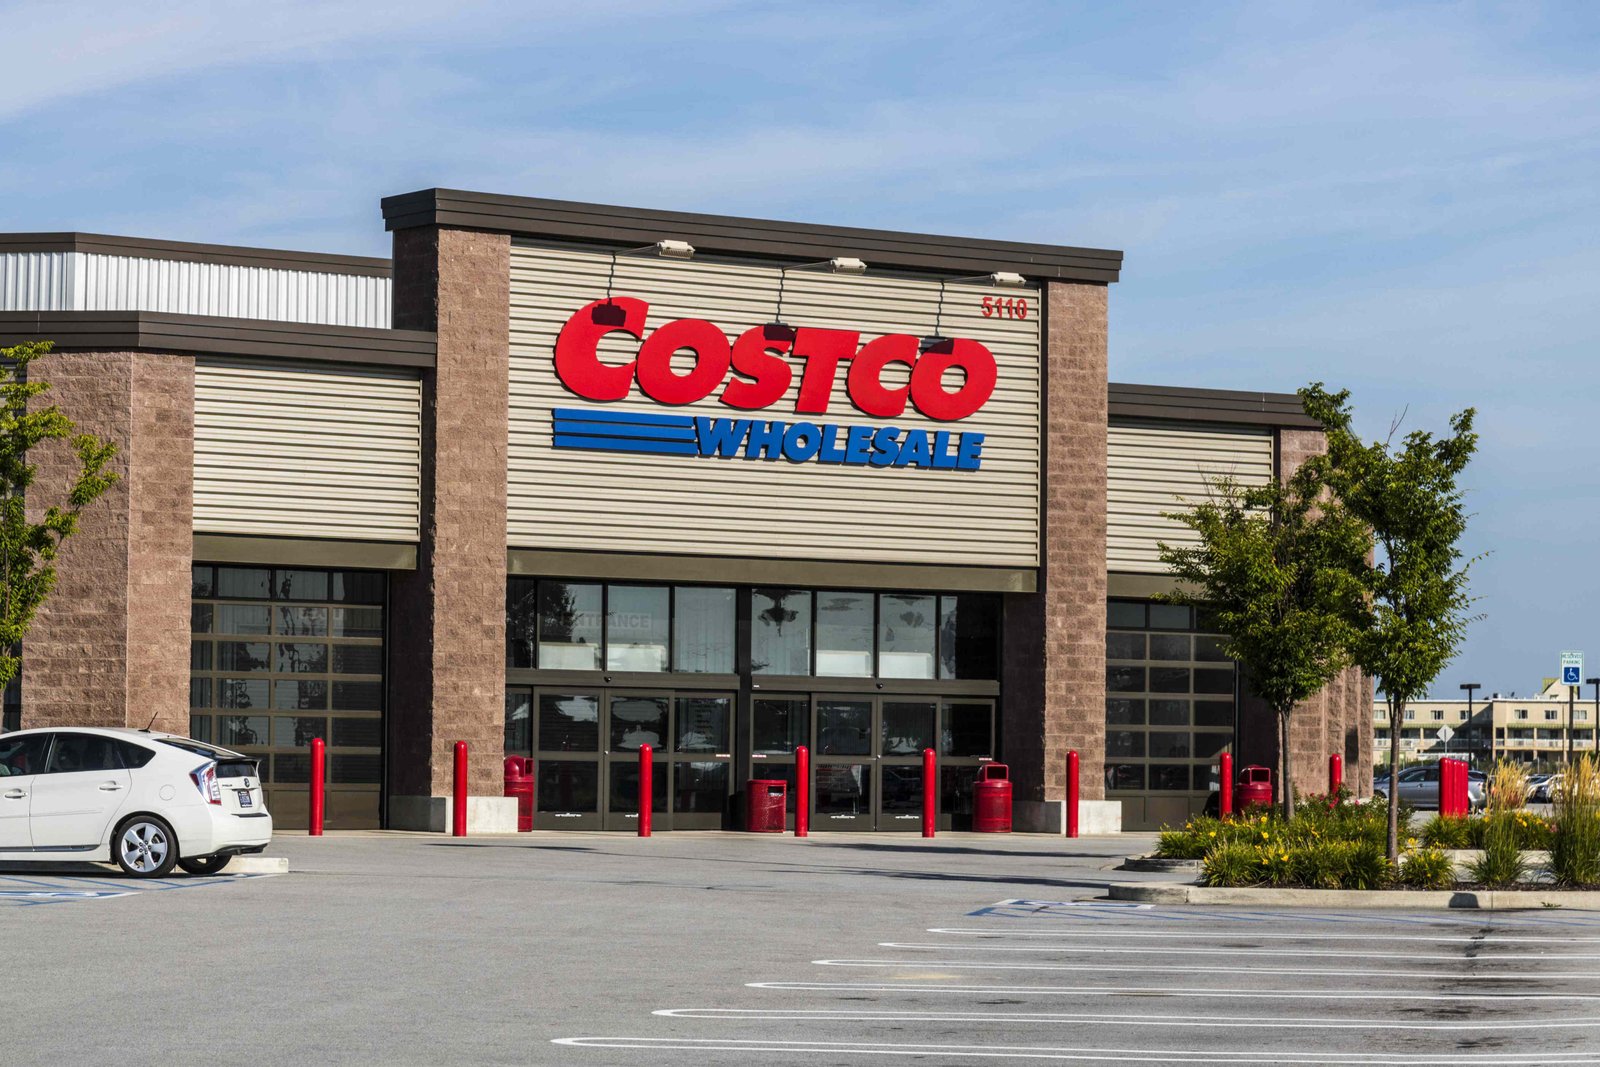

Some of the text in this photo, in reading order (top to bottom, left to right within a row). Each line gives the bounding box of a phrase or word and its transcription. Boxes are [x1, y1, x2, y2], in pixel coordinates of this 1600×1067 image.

[981, 296, 1027, 320] 5110
[555, 297, 997, 421] COSTCO
[695, 416, 985, 470] WHOLESALE
[563, 612, 650, 629] NTRANCE
